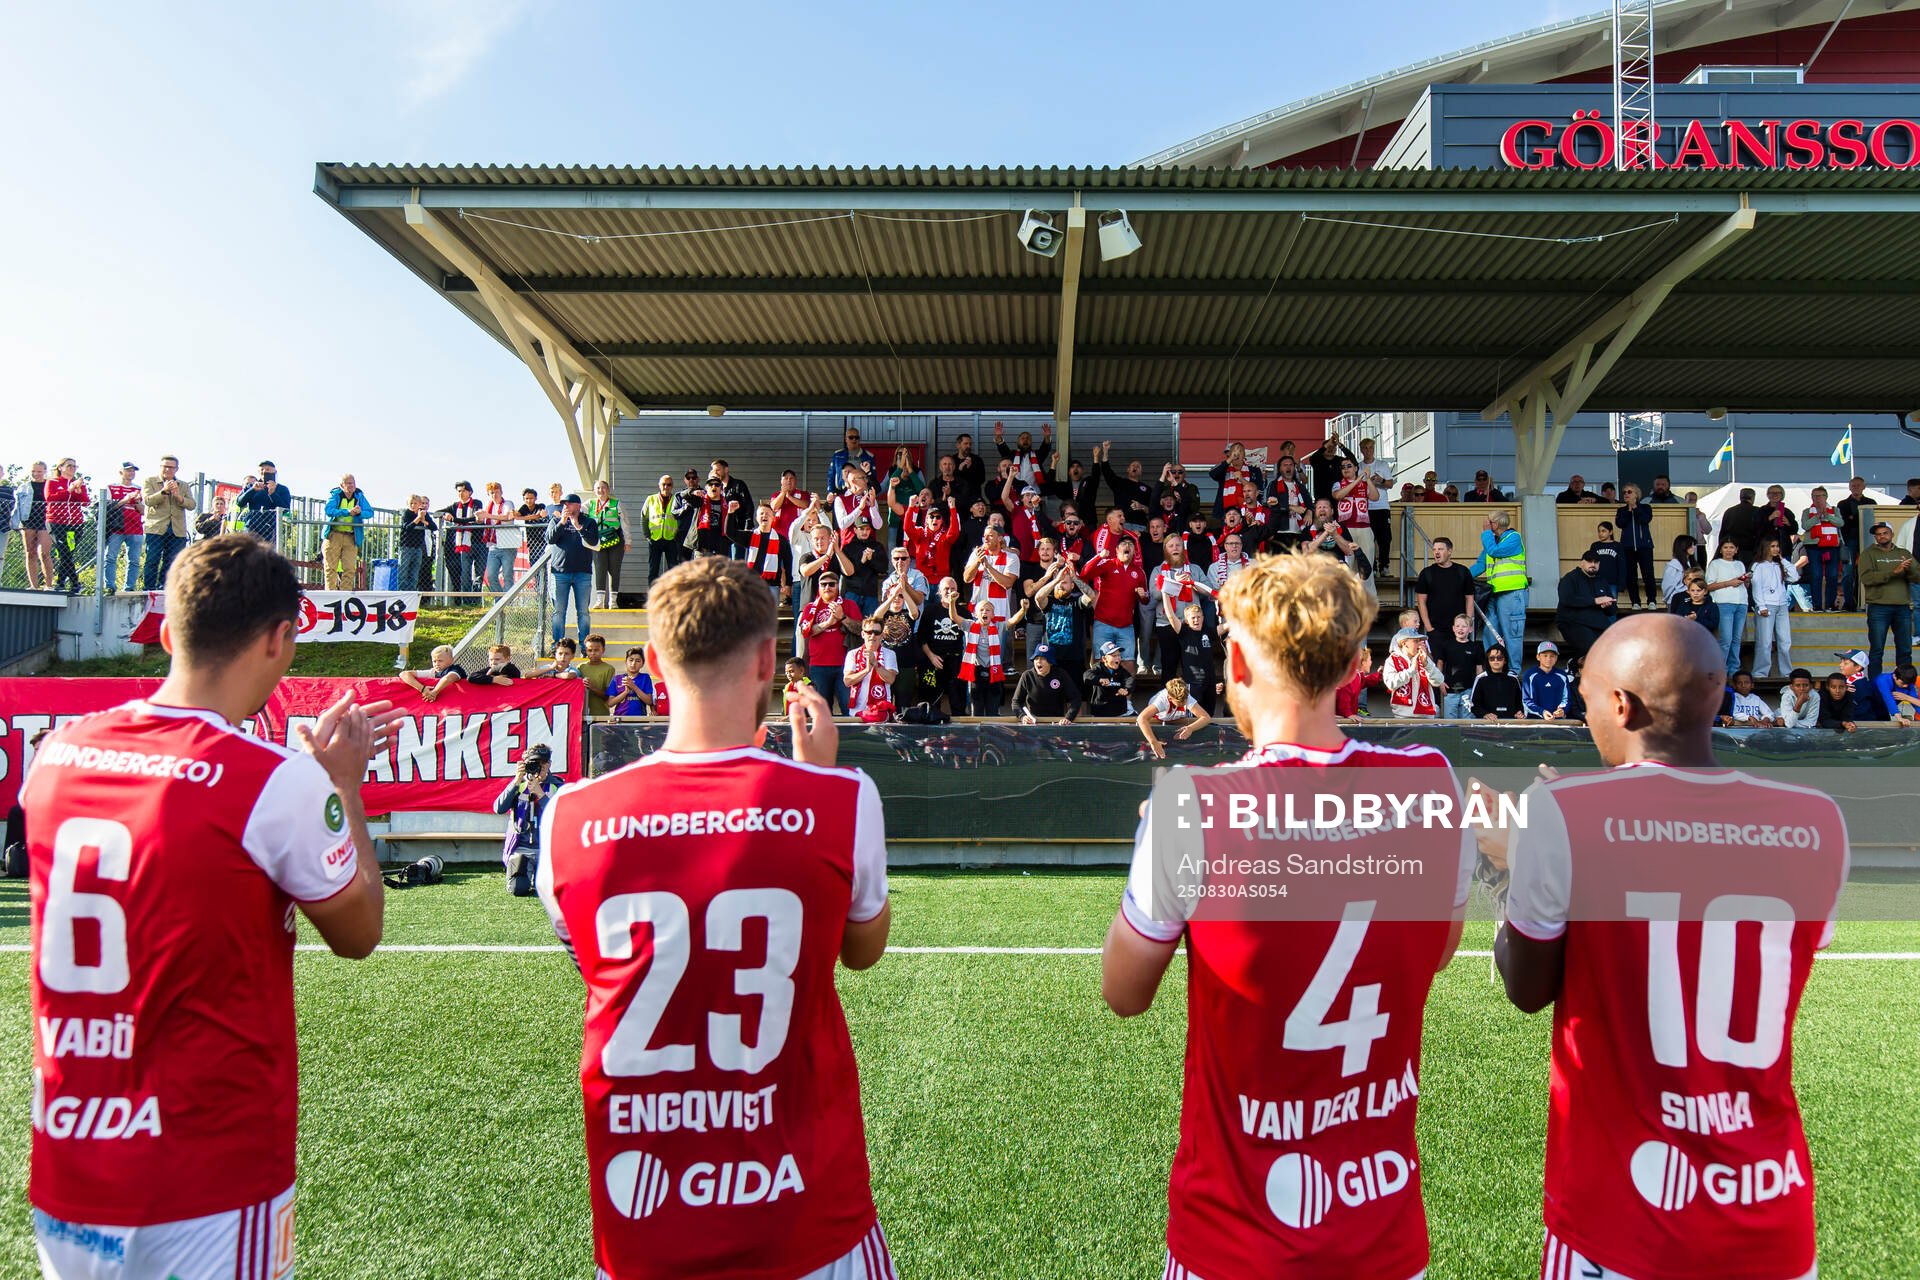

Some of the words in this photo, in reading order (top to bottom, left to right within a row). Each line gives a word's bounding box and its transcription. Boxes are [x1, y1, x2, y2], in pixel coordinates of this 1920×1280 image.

[1500, 109, 1920, 170] GÖRANSSO
[324, 597, 407, 635] 1918
[581, 807, 815, 848] (LUNDBERG&CO)
[1604, 817, 1820, 850] (LUNDBERG&CO)
[41, 817, 133, 995] 6
[595, 887, 804, 1078] 23
[1283, 900, 1390, 1078] 4
[1625, 891, 1796, 1070] 10
[45, 1096, 163, 1140] GIDA
[609, 1083, 778, 1134] ENGQVIST
[1238, 1094, 1304, 1141] VAN
[1311, 1086, 1361, 1136] DER
[1366, 1058, 1419, 1118] LAN
[1660, 1091, 1754, 1135] SIMBA
[679, 1153, 805, 1207] GIDA
[1336, 1149, 1417, 1208] GID
[1702, 1149, 1806, 1205] GIDA
